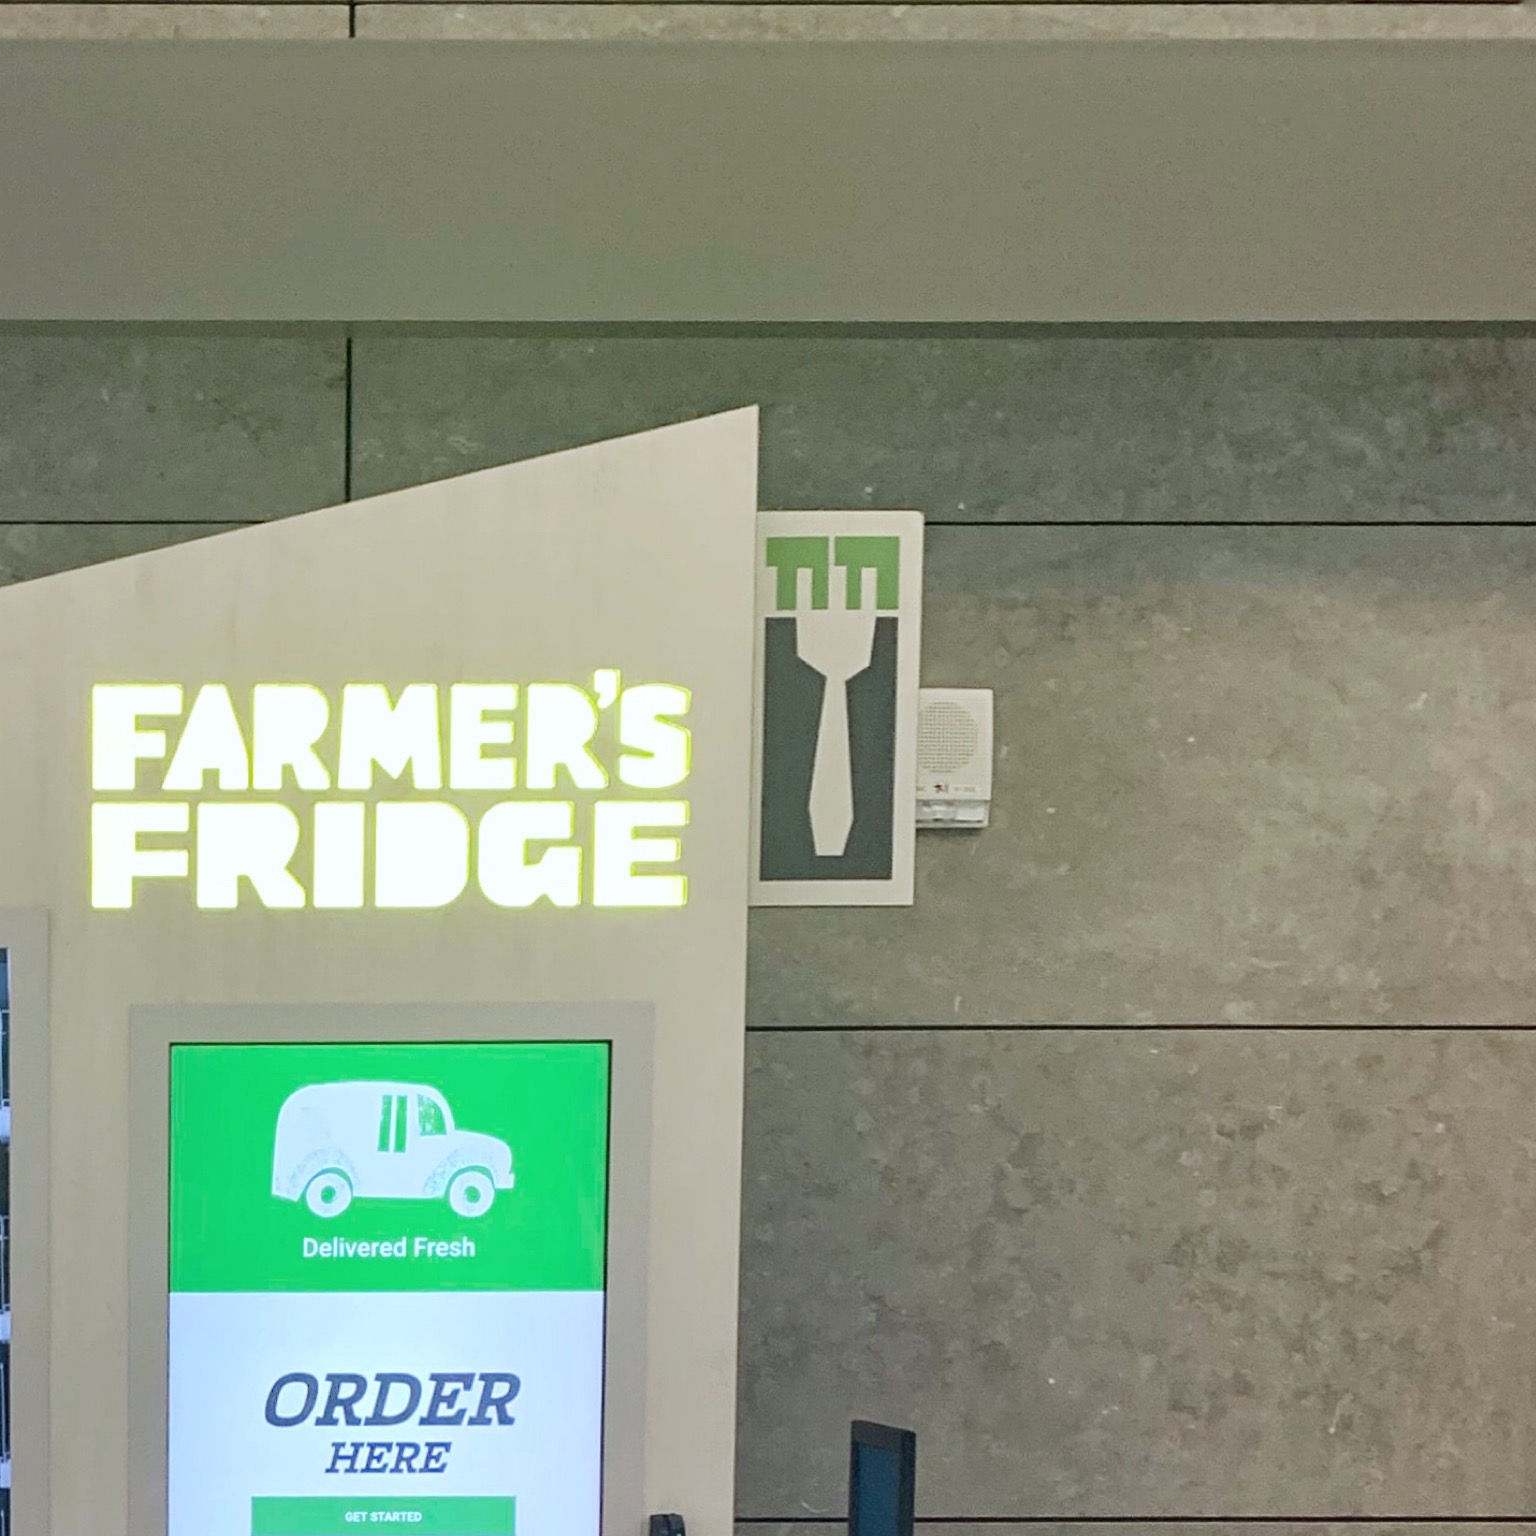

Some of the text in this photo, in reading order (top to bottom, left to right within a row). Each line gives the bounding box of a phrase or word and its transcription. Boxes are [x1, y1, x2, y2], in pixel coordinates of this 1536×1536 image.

[91, 668, 691, 790] FARMER'S
[91, 800, 690, 909] FRIDGE
[302, 1236, 476, 1258] Delivered Fresh
[264, 1372, 522, 1427] ORDER
[324, 1442, 453, 1474] HERE
[345, 1511, 423, 1523] GET STARTED
